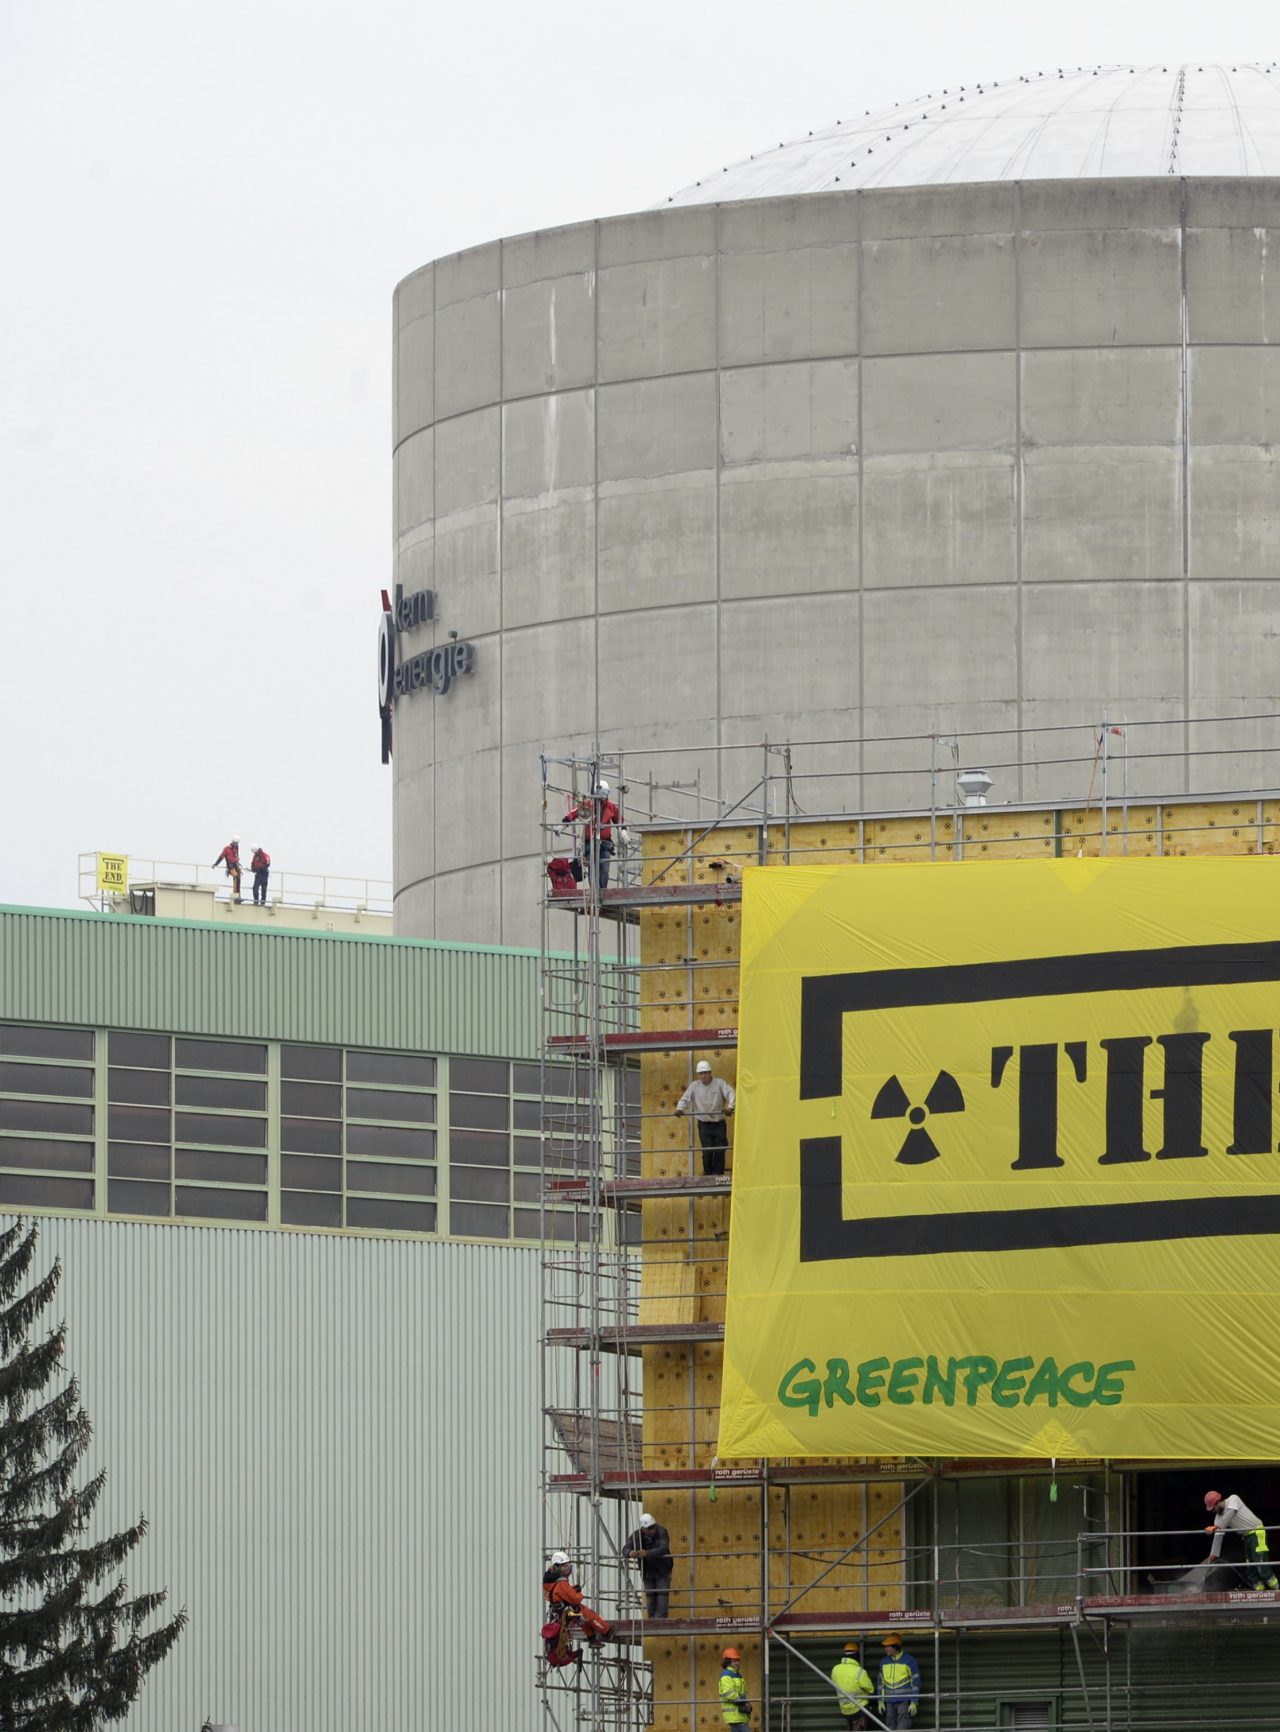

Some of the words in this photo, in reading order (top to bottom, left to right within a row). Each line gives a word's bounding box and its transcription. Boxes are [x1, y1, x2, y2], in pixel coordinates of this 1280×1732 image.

[396, 583, 434, 633] kern
[394, 630, 473, 696] energie
[104, 861, 122, 871] THE
[105, 871, 122, 882] END
[777, 1354, 1136, 1417] GREENPEACE
